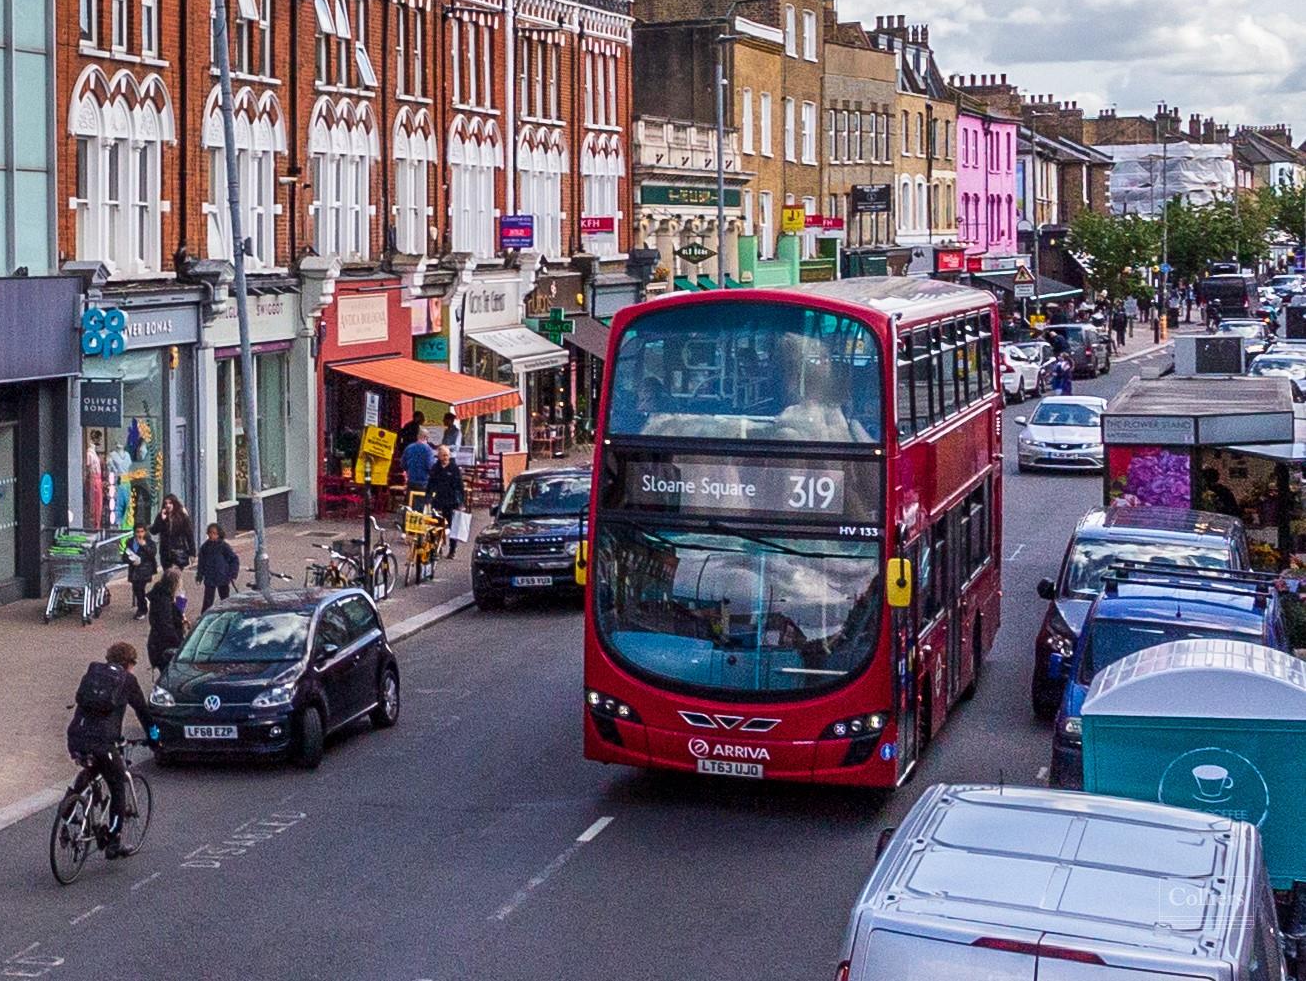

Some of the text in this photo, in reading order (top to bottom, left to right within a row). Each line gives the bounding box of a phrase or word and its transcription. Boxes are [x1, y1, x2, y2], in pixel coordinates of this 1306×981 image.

[581, 219, 600, 228] KFH
[125, 320, 173, 337] IVER BONAS
[84, 405, 117, 413] BONAS
[642, 474, 835, 509] Sloane Square 319
[839, 526, 879, 537] HV 133
[713, 744, 770, 760] ARRIVA
[702, 760, 732, 773] LT63
